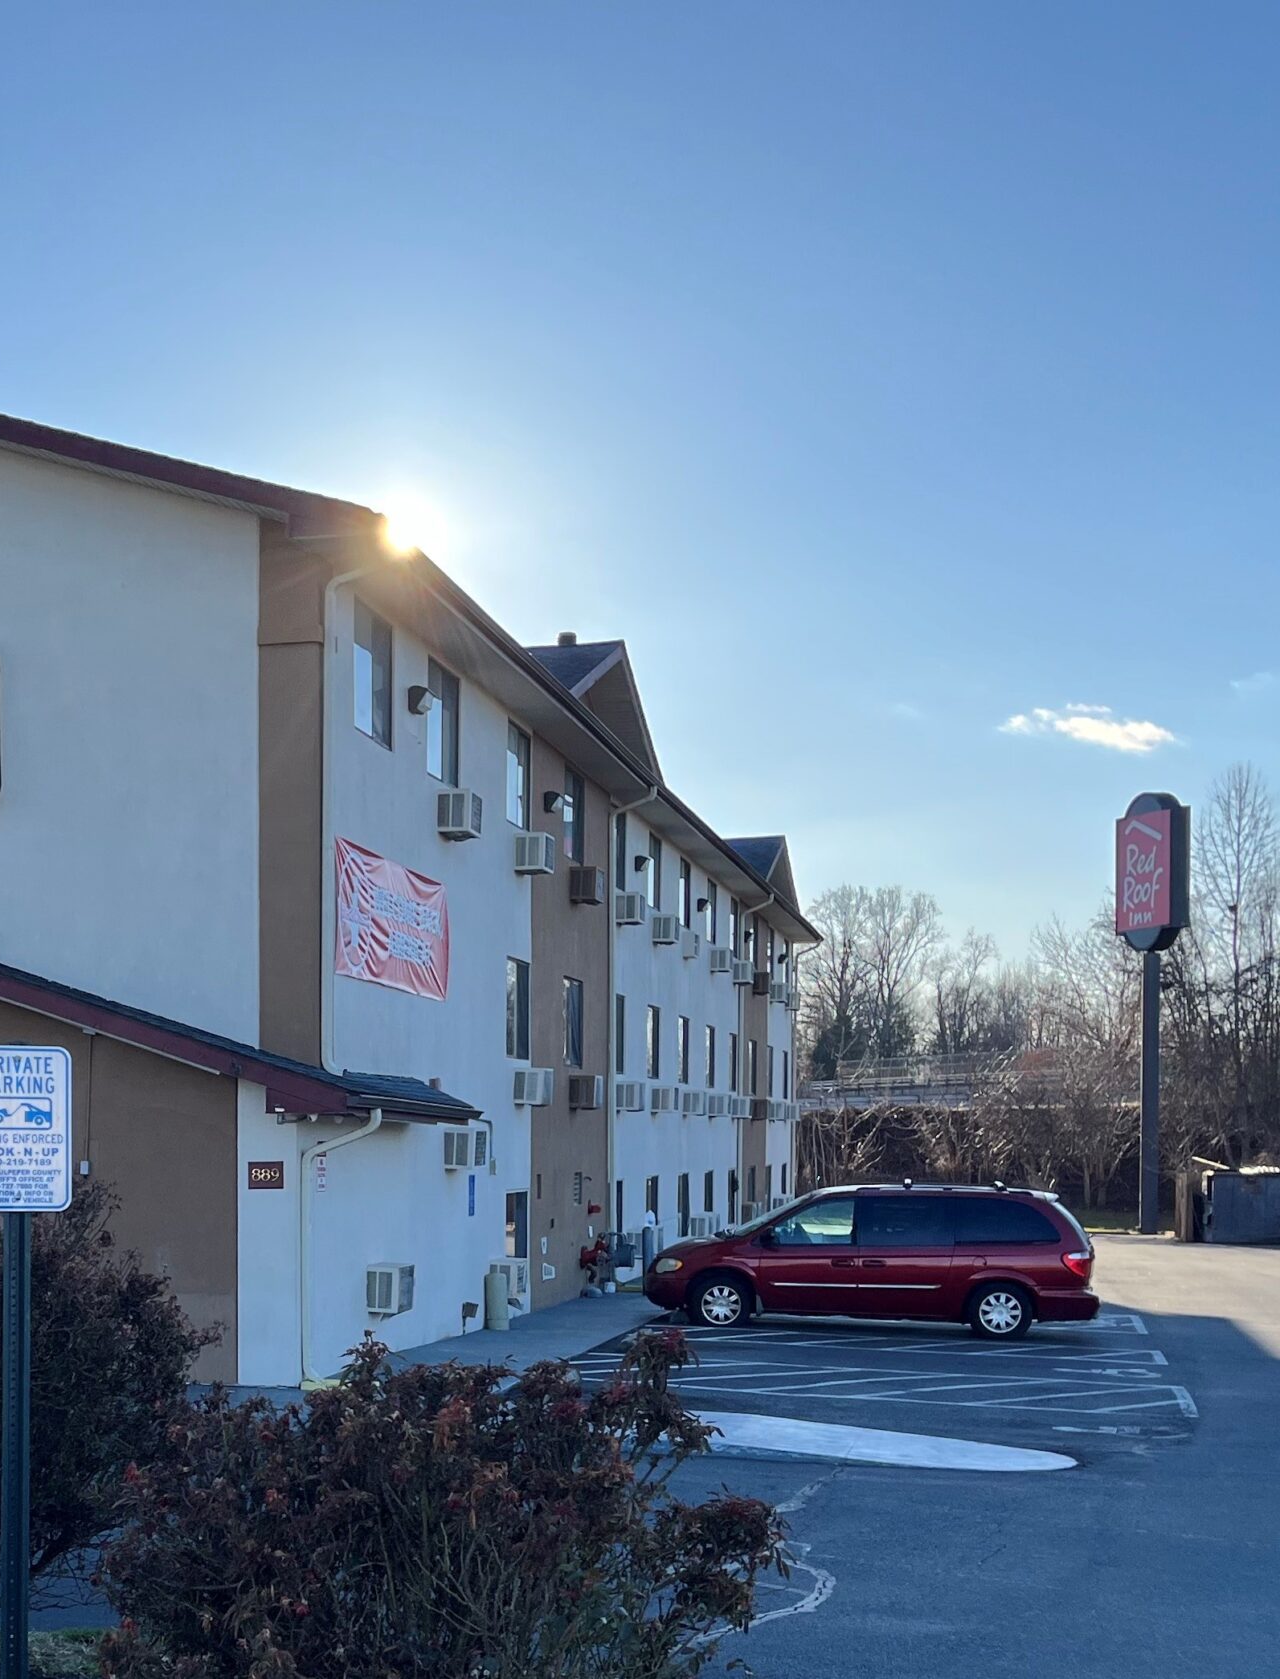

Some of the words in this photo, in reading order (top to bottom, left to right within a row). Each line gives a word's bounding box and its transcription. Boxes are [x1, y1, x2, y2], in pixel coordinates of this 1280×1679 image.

[1126, 843, 1157, 876] Red
[1123, 867, 1163, 912] Roof
[12, 1133, 63, 1145] ENFORCED
[251, 1168, 280, 1182] 889
